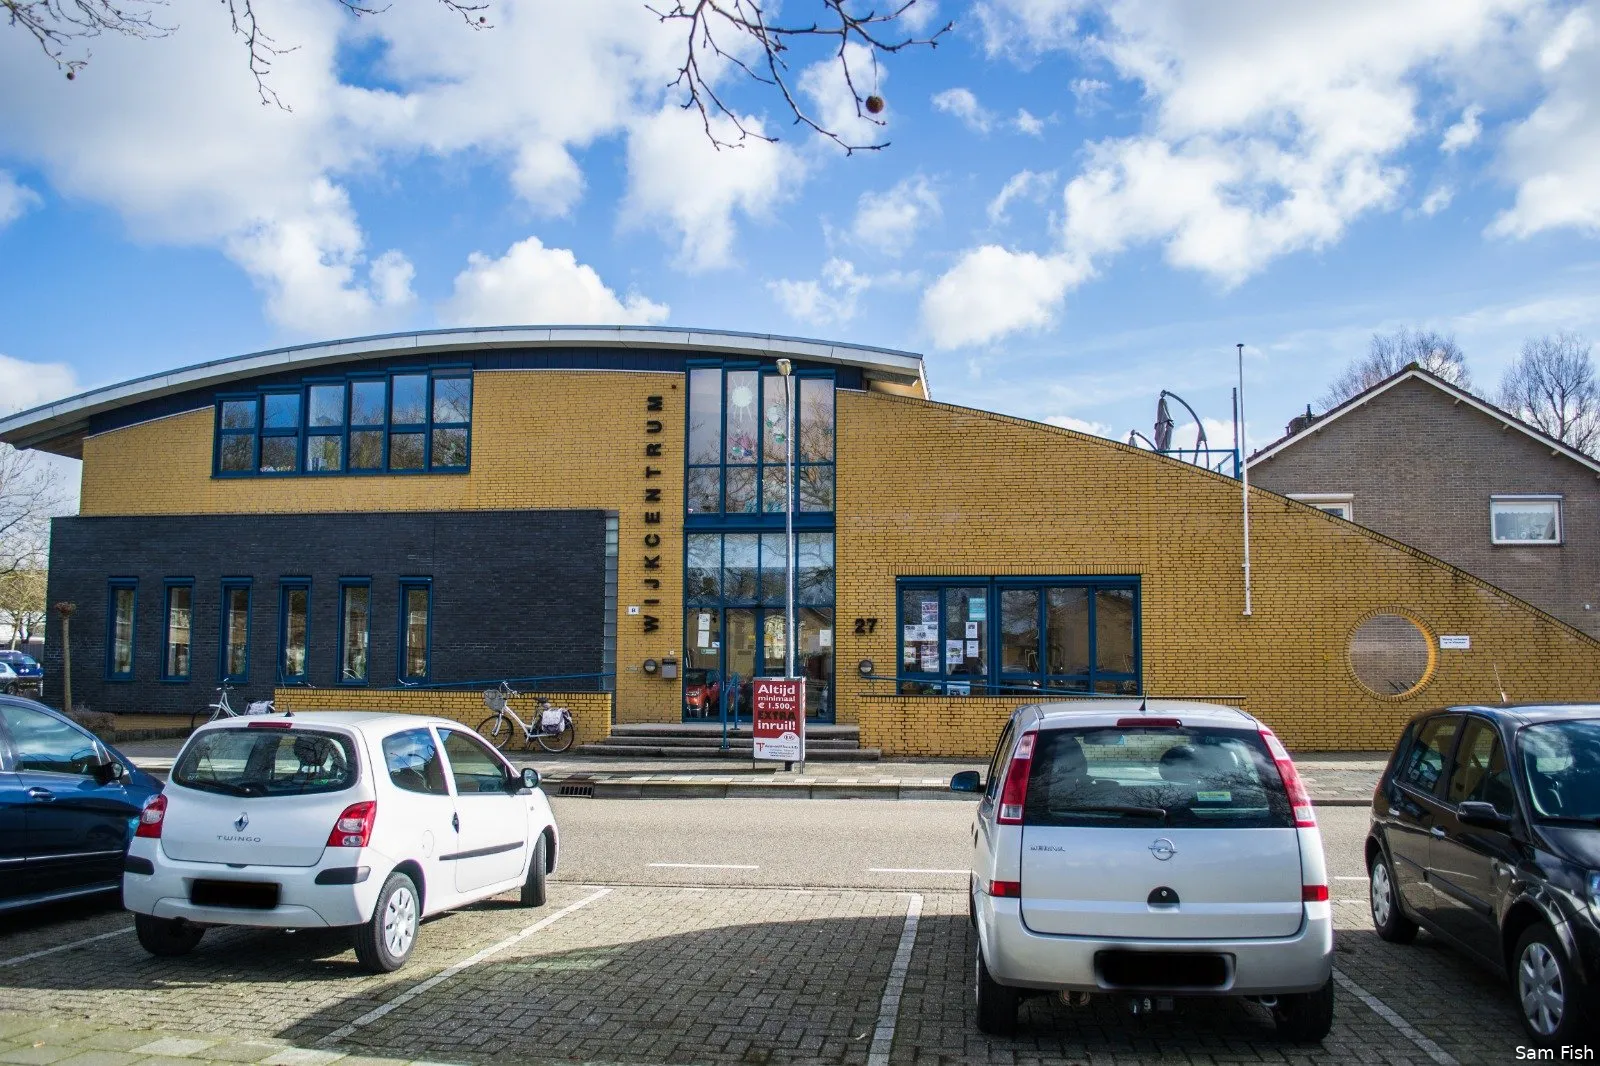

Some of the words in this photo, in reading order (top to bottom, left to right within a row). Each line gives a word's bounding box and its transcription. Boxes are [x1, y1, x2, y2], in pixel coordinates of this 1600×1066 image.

[644, 395, 663, 633] WIJKCENTRUM
[855, 617, 878, 634] 27
[757, 684, 796, 697] Altijd
[768, 702, 796, 711] 1.500,-
[758, 710, 797, 721] EXTRA
[757, 720, 796, 731] inruil!
[216, 834, 262, 843] TWINGO
